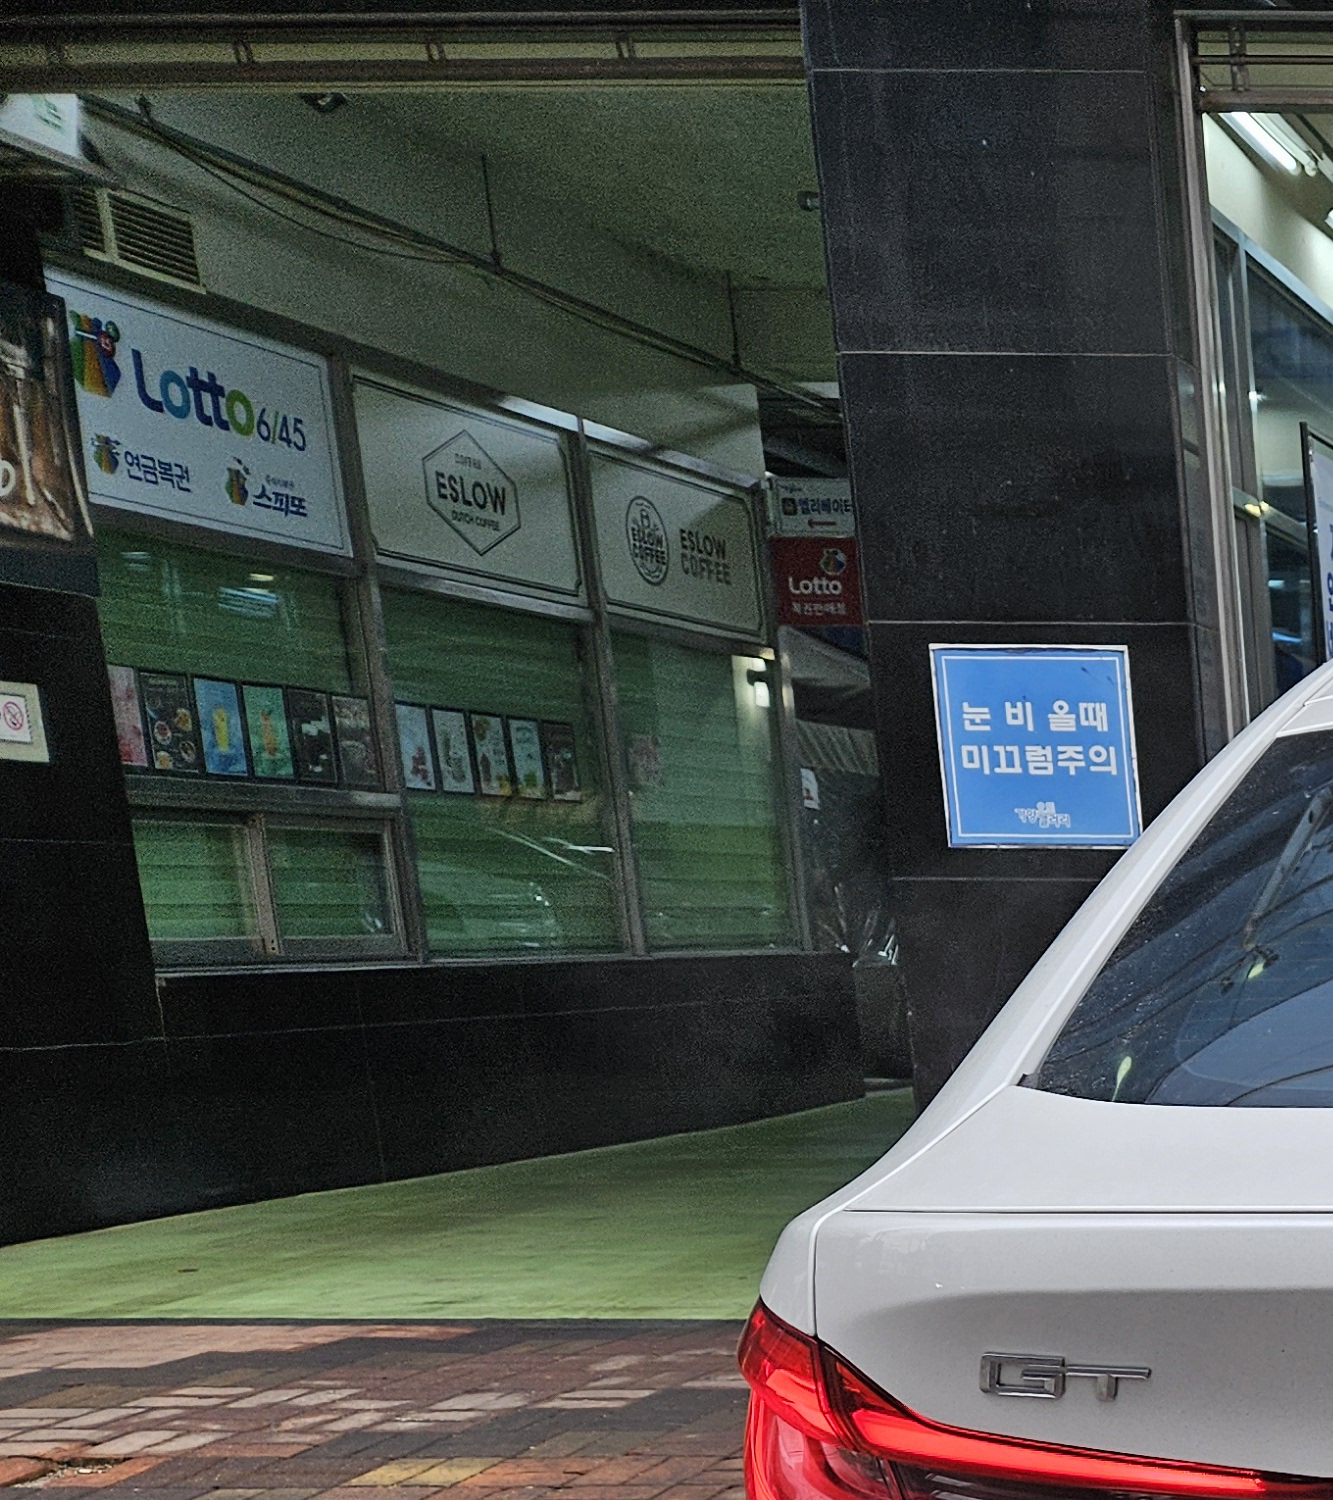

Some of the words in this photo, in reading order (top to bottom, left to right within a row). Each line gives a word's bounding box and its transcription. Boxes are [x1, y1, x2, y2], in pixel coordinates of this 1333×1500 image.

[131, 348, 255, 437] Lotto
[256, 408, 307, 452] 6/45
[124, 450, 192, 493] 연금복권
[253, 484, 308, 517] 스피또
[435, 470, 506, 516] ESLOW
[679, 528, 726, 560] ESLOW
[680, 552, 733, 586] COFFEE
[788, 576, 842, 595] Lotto
[962, 701, 991, 731] 눈
[1004, 701, 1034, 732] 비
[1047, 700, 1108, 732] 올때
[961, 744, 1118, 776] 미끄럼주의
[979, 1351, 1152, 1401] GT
